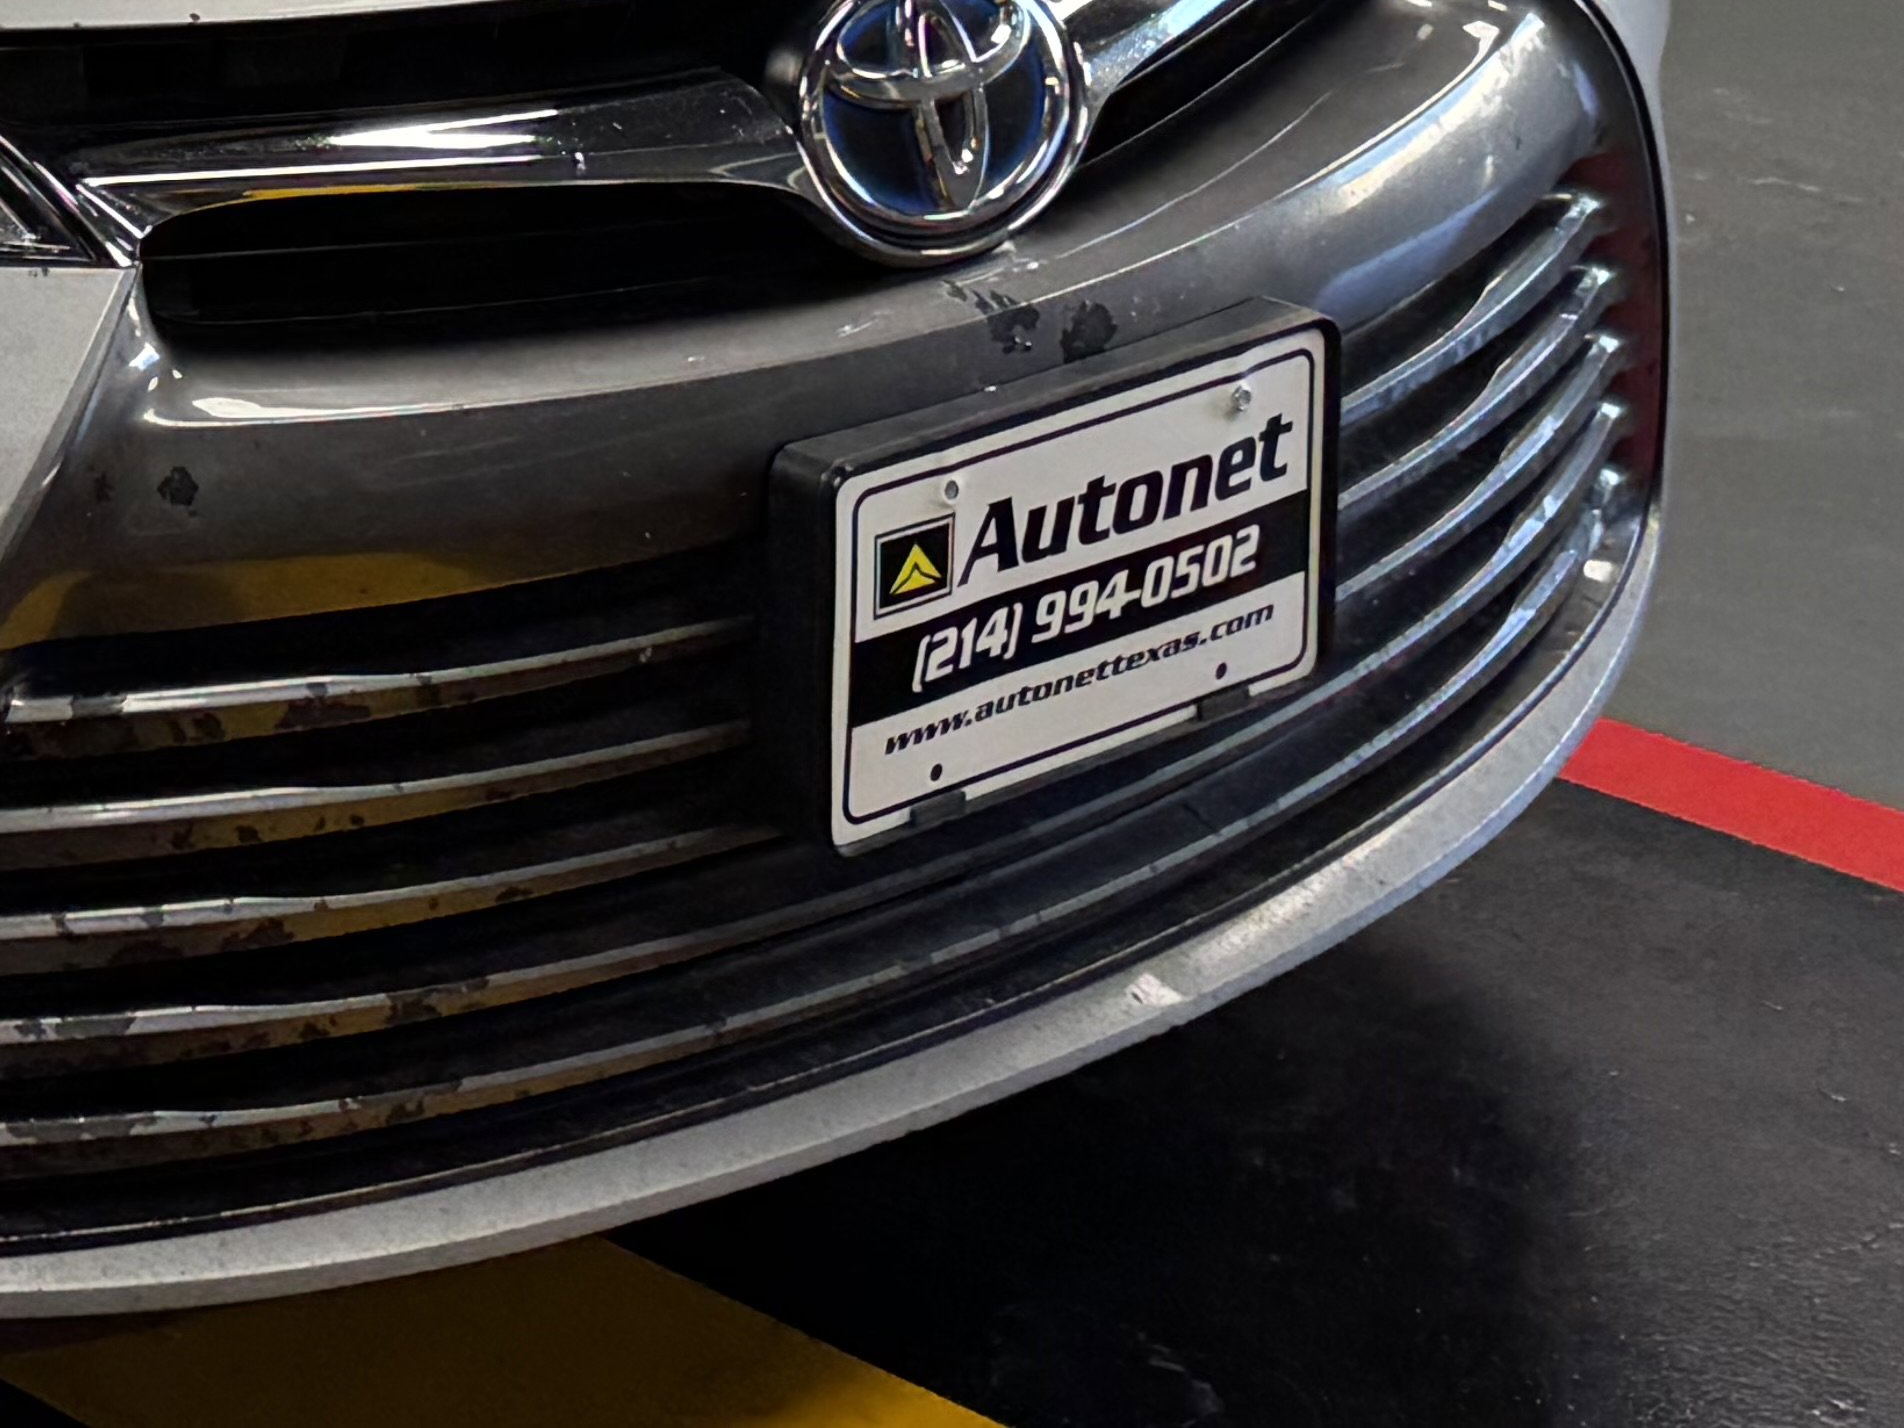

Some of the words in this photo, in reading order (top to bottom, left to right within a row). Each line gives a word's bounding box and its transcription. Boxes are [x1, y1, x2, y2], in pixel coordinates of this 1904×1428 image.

[956, 412, 1293, 588] Autonet
[884, 602, 1274, 756] www.autonettexas.com
[911, 602, 1023, 693] (214)
[1030, 523, 1261, 644] 994-0502
